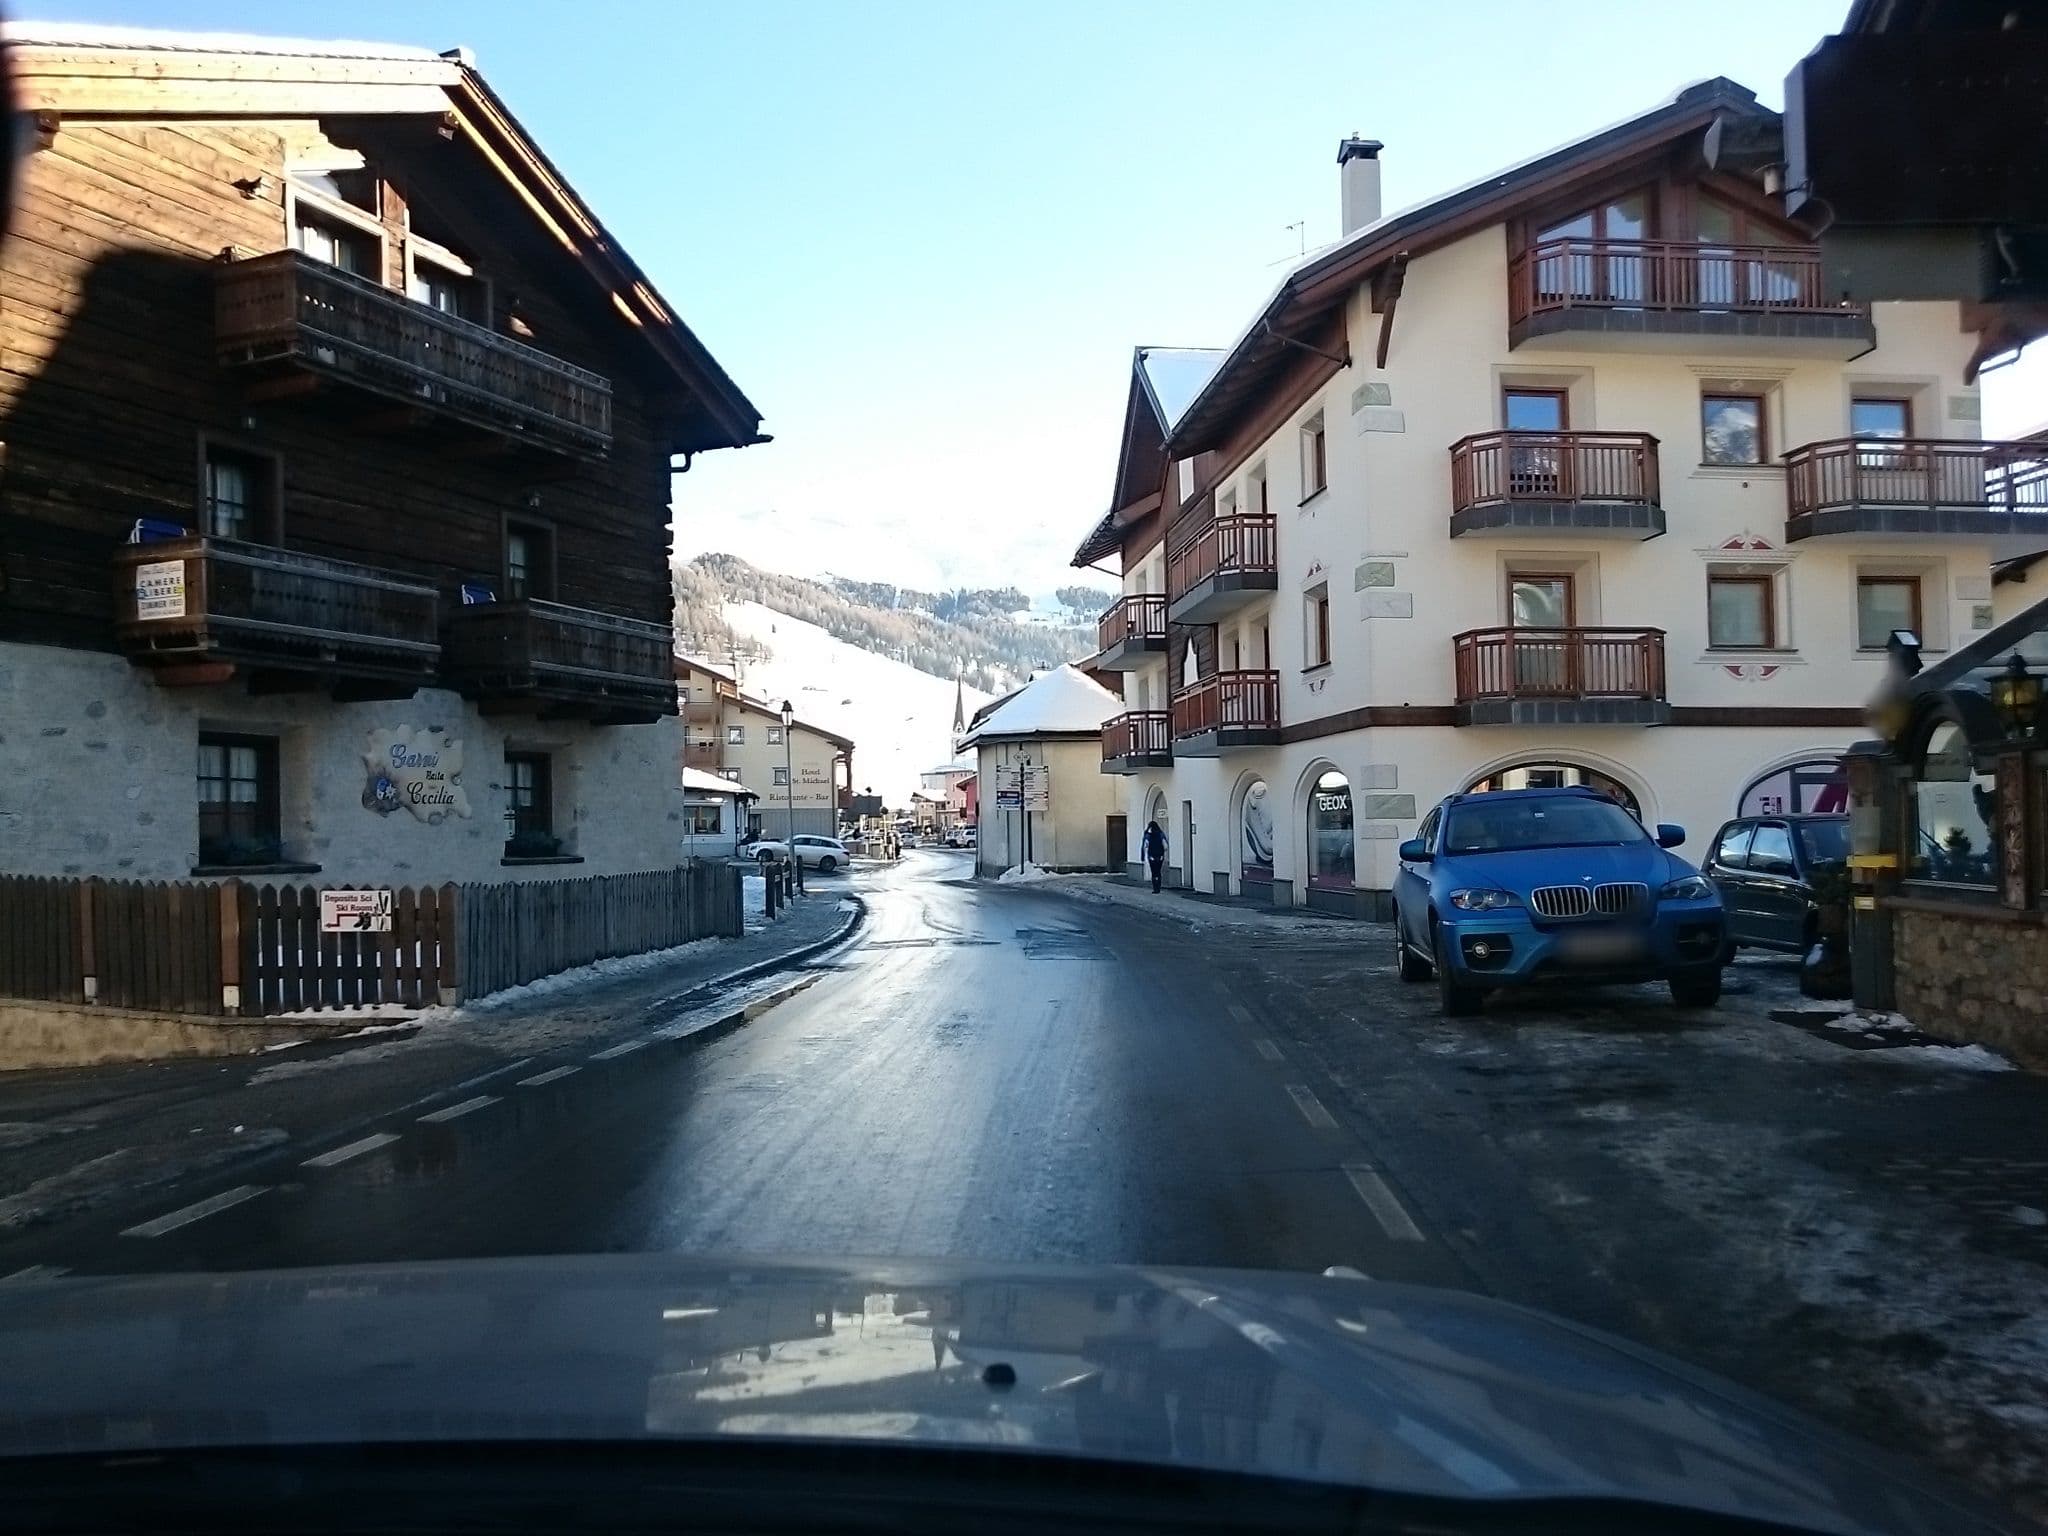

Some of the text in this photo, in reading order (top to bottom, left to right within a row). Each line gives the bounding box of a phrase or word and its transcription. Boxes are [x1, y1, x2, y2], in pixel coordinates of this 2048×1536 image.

[140, 577, 181, 588] CAMERE
[407, 782, 455, 805] Cecilia
[1319, 795, 1347, 811] GEOX
[336, 904, 372, 912] Ski Room
